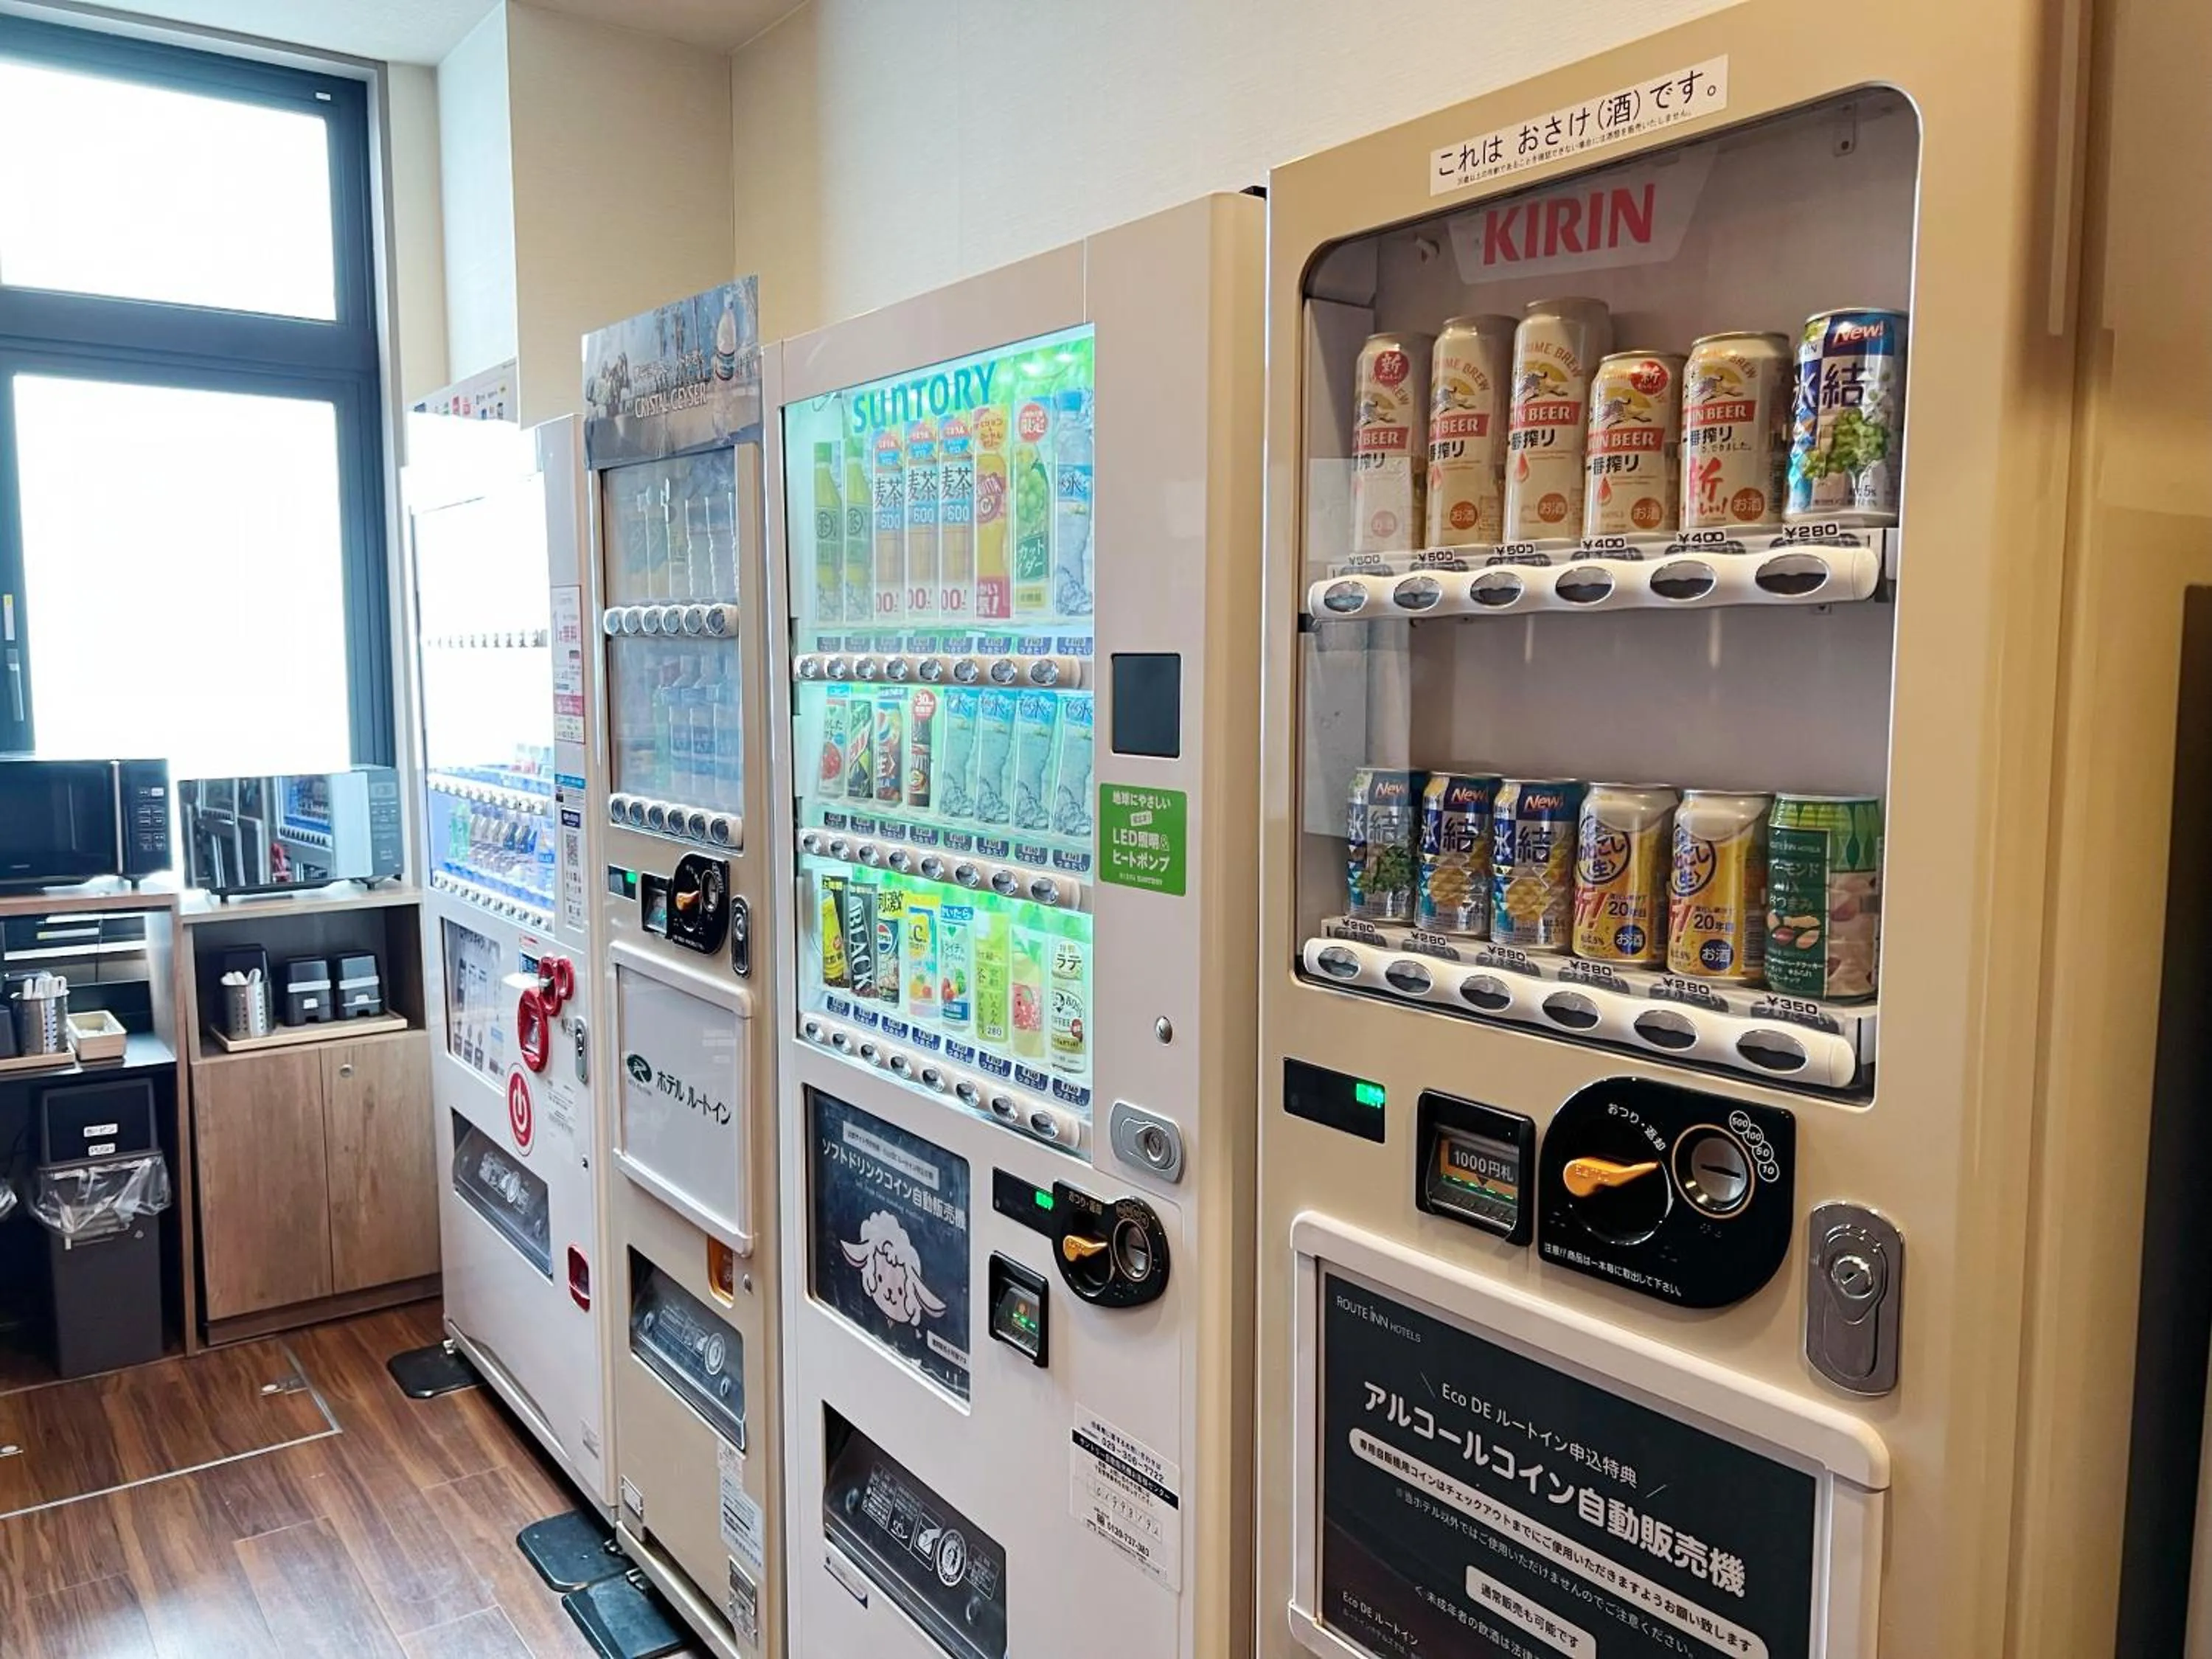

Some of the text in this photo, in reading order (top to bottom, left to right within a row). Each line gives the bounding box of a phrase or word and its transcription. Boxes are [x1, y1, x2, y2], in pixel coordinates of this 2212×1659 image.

[1439, 135, 1503, 176] これは
[1483, 184, 1655, 265] KIRIN
[1834, 321, 1884, 344] New!
[853, 361, 995, 434] SUNTORY
[1529, 405, 1572, 421] BEER
[1706, 405, 1746, 420] BEER
[1442, 418, 1478, 434] BEER
[1364, 431, 1399, 445] BEER
[1613, 431, 1655, 446] BEER
[942, 466, 972, 499] 麦茶
[1734, 495, 1762, 510] お酒
[1632, 507, 1660, 521] お酒
[1677, 532, 1725, 544] ¥400
[1784, 524, 1837, 538] ¥280
[1582, 538, 1625, 551] ¥400
[1113, 849, 1170, 873] ヒートポンプ
[849, 905, 874, 990] BLACK
[1411, 931, 1446, 946] ¥280
[1615, 931, 1645, 947] お酒
[1056, 953, 1082, 971] ラテ
[1487, 945, 1526, 961] ¥280
[1701, 950, 1732, 965] お酒
[1569, 960, 1613, 977] ¥280
[1663, 977, 1709, 995] ¥280
[1767, 995, 1818, 1015] ¥350
[987, 1026, 1002, 1037] 280
[656, 1070, 685, 1102] ホテル
[687, 1085, 732, 1125] ルートイン
[1453, 1150, 1514, 1182] 1000円札
[821, 1138, 967, 1232] ソフトドリンクコイン自動販売機
[1336, 1295, 1368, 1321] ROUTE
[1390, 1323, 1422, 1343] HOTELS
[1441, 1382, 1638, 1489] Eco DE ルートイン申込特典
[1363, 1380, 1746, 1599] アルコールコイン自動販売機
[1481, 1582, 1579, 1649] 通常販売も可能です
